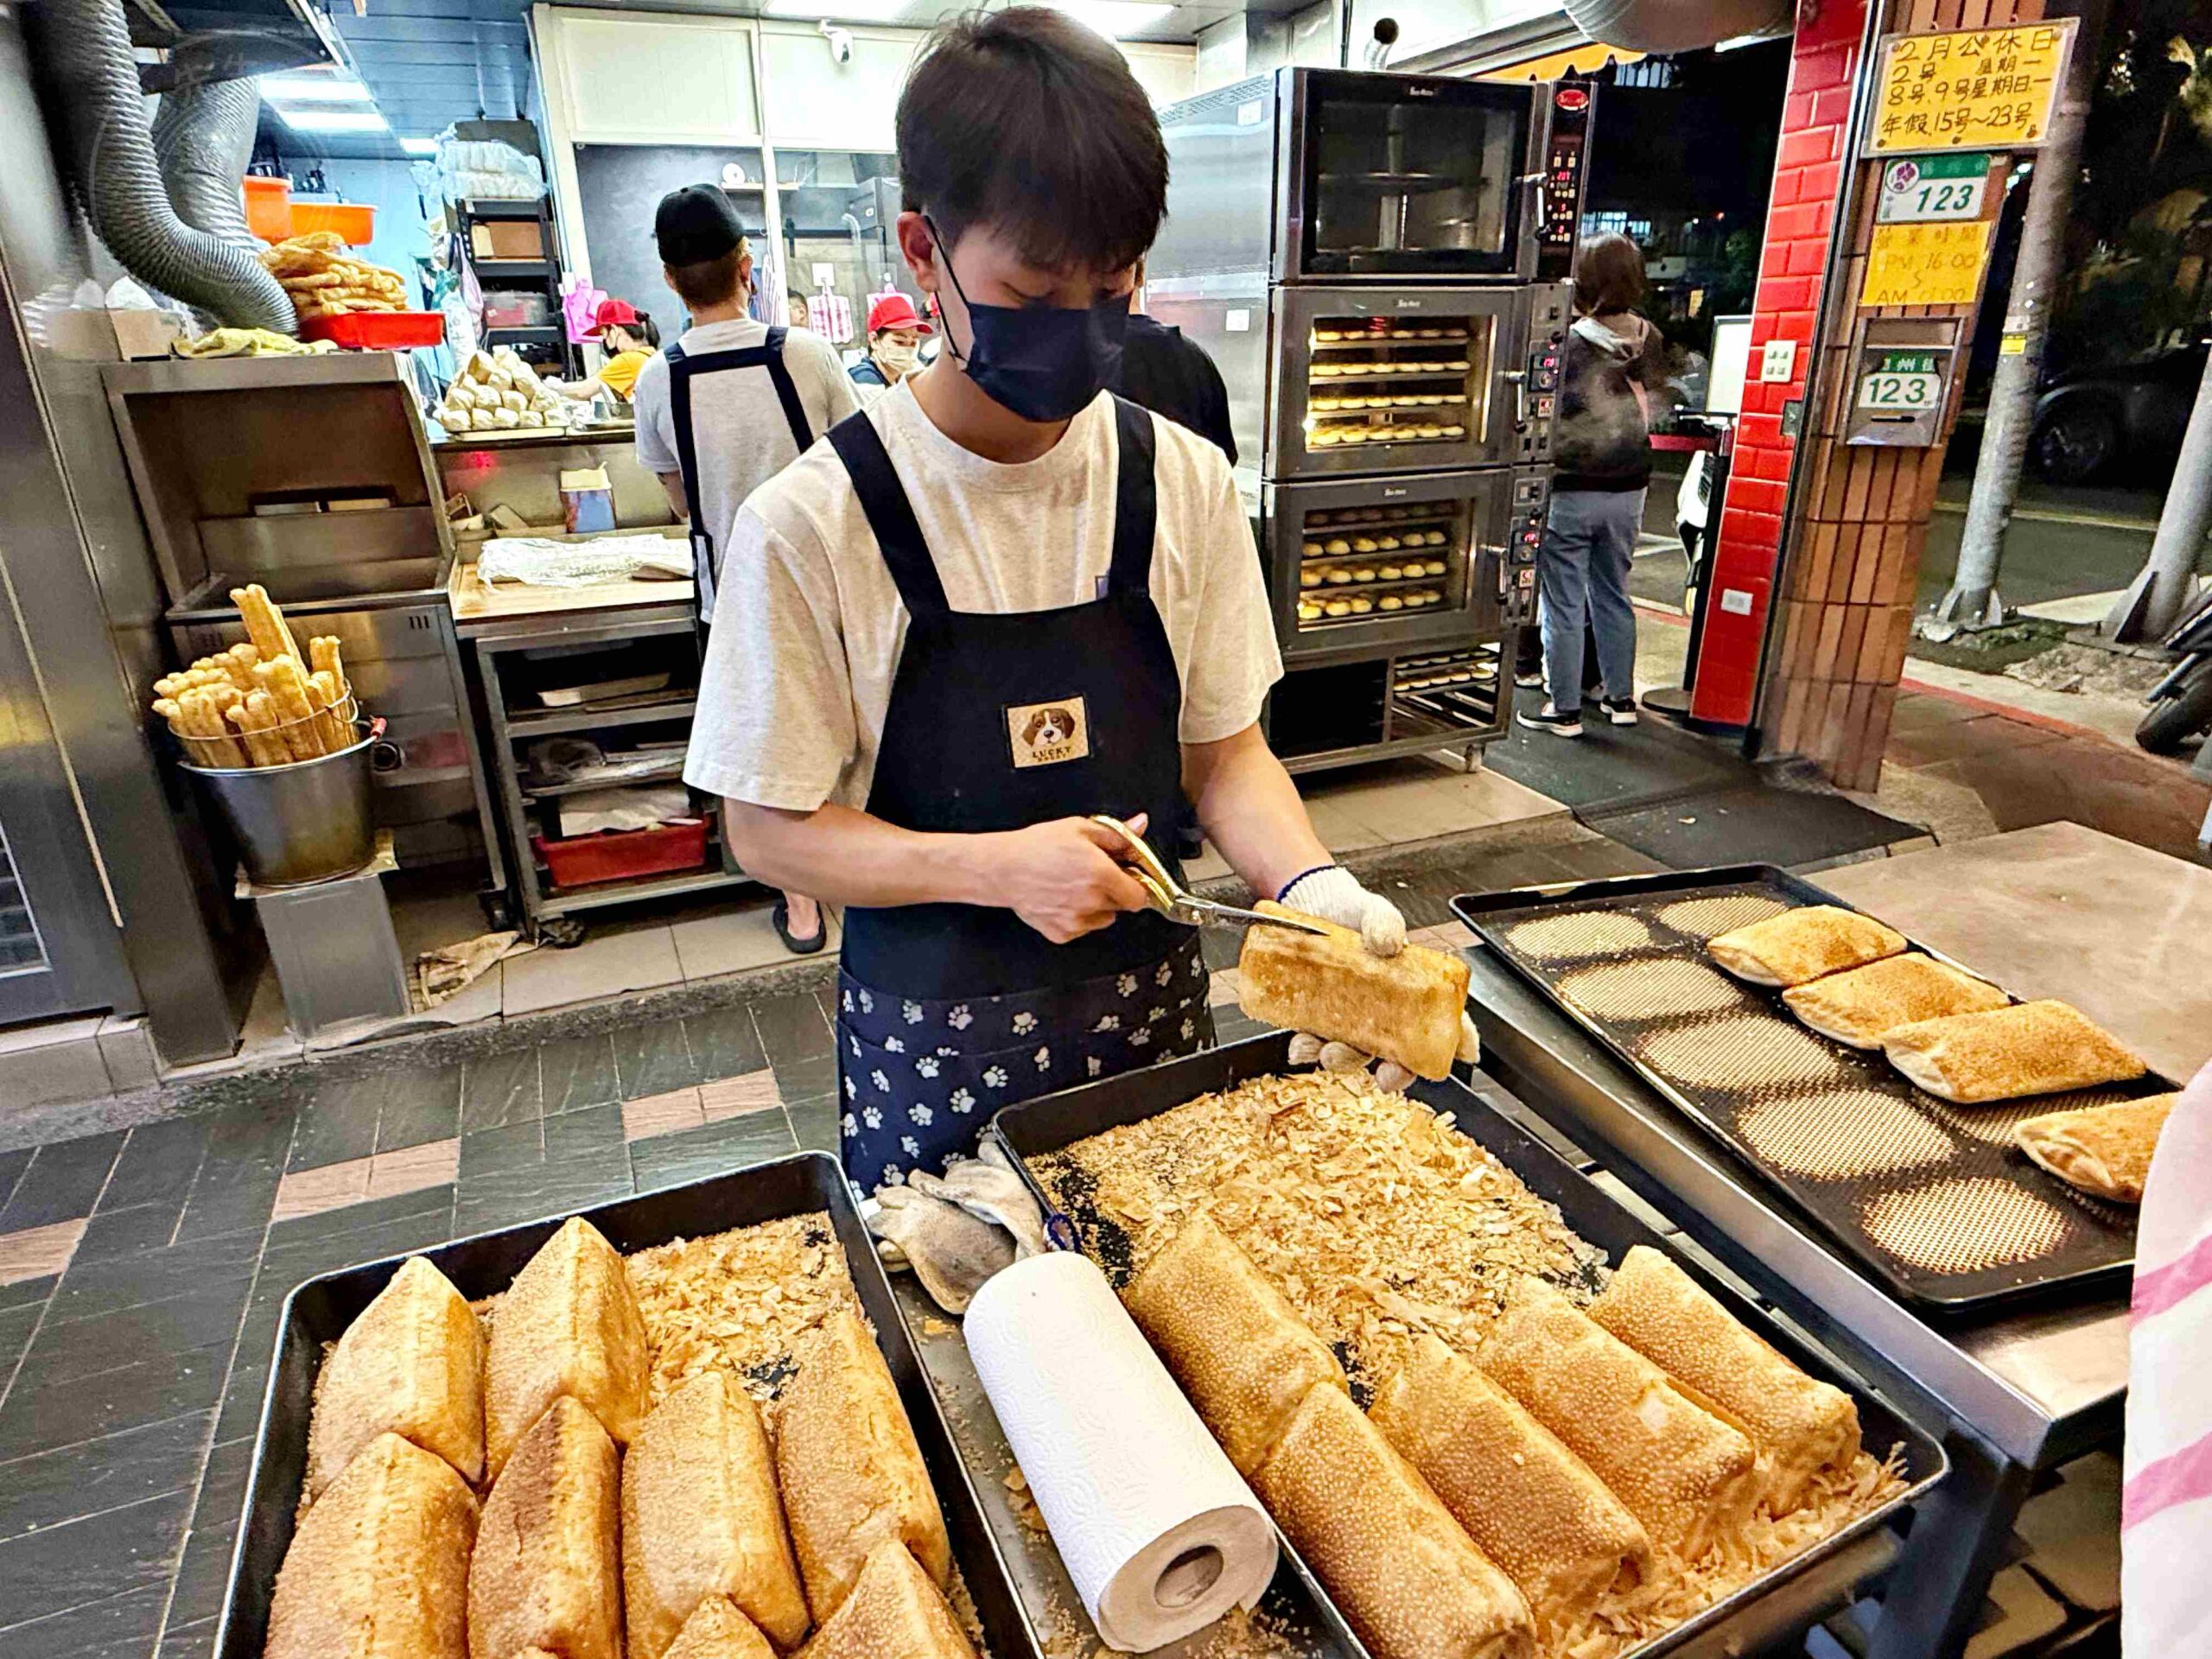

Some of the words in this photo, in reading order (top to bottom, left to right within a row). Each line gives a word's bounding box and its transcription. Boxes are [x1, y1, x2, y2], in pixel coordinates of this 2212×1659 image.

[1895, 29, 2054, 62] 2月公休日
[1917, 184, 1974, 213] 123
[1869, 378, 1926, 404] 123
[1033, 746, 1071, 759] LUCKY
